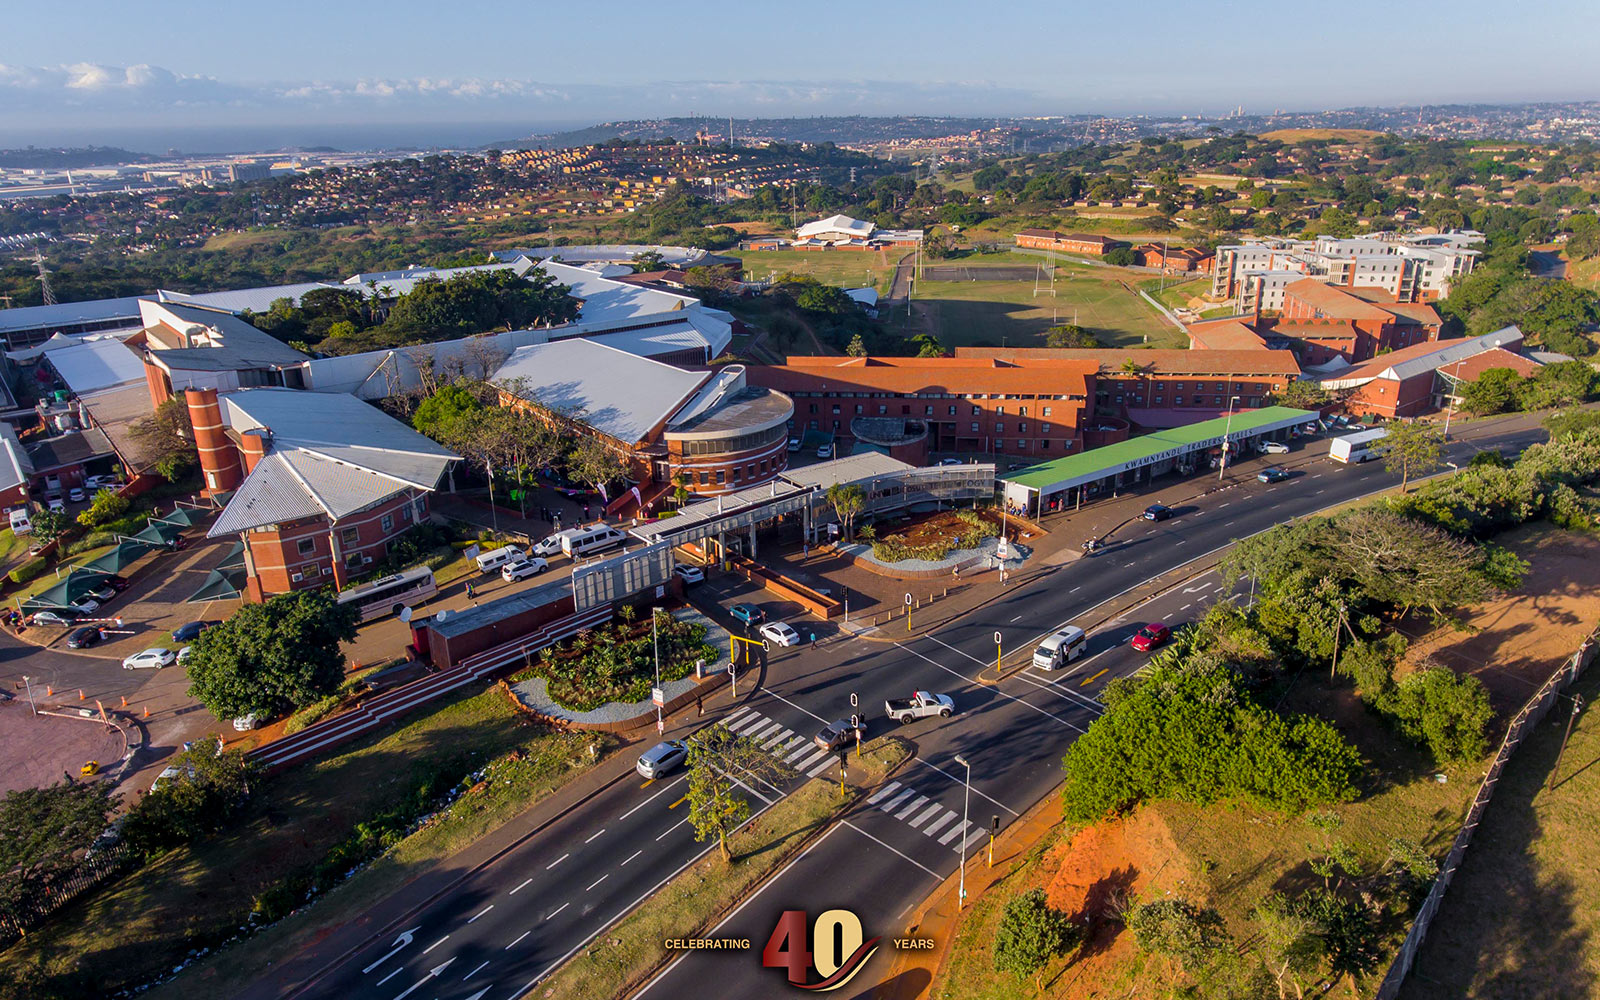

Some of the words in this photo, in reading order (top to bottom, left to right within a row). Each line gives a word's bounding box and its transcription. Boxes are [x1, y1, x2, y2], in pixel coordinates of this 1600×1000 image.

[1125, 448, 1182, 470] KWAMNYANDU
[1188, 437, 1223, 451] TRADERS
[1228, 430, 1253, 441] STALLS
